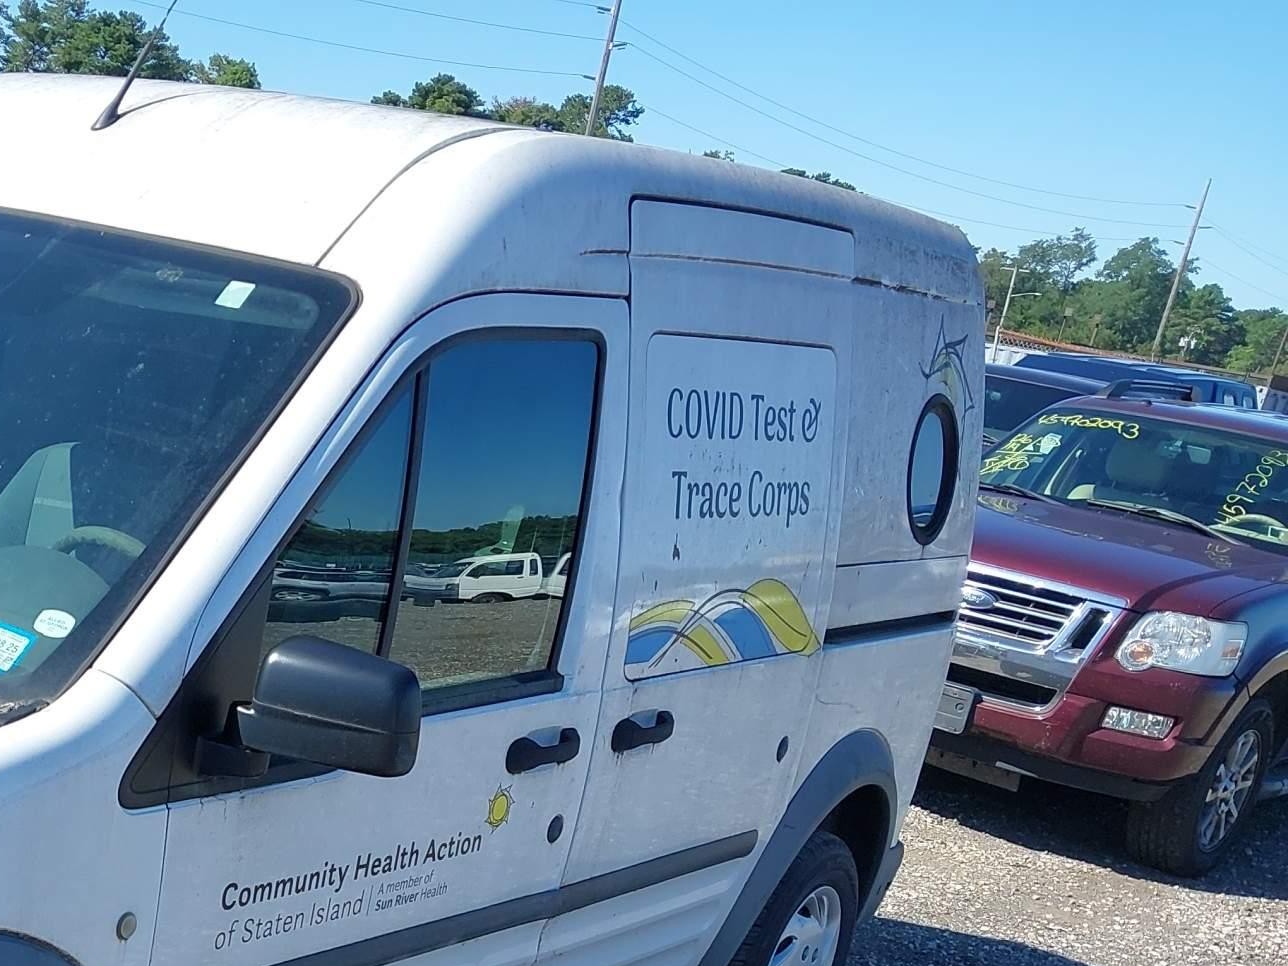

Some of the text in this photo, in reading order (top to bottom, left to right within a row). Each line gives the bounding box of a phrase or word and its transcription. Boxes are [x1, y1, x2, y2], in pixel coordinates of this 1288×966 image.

[667, 388, 821, 443] COVID Test &
[672, 471, 810, 528] Trace Corps
[221, 831, 483, 911] Community Health Action
[375, 882, 448, 912] Sun River Health
[377, 869, 434, 895] A member of
[214, 889, 365, 949] of Staten Island
